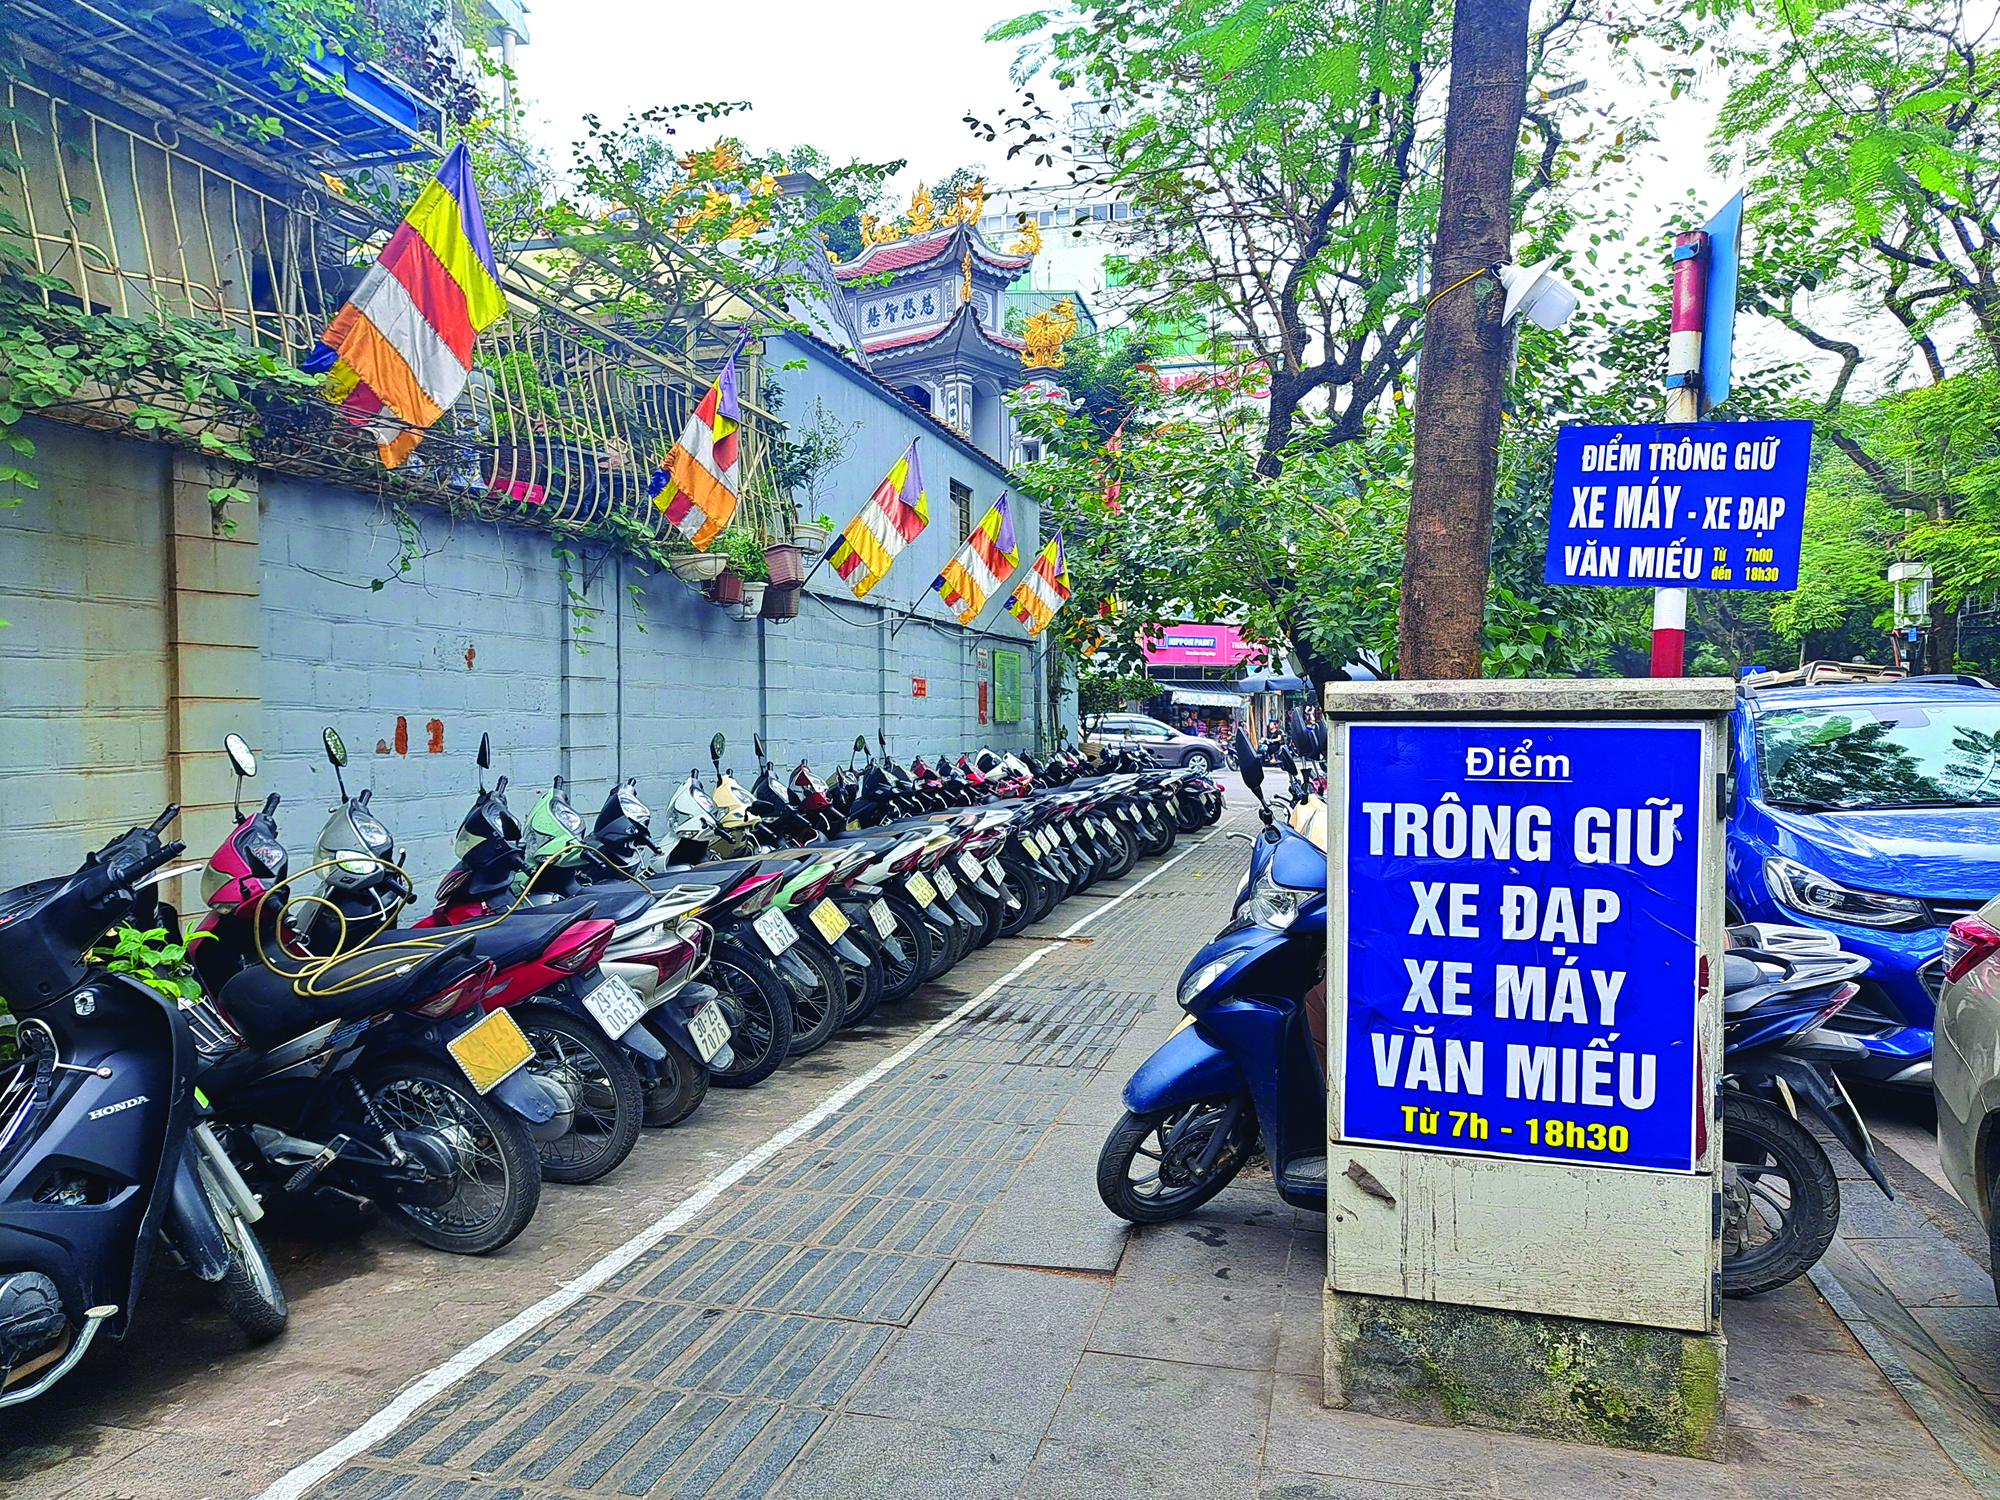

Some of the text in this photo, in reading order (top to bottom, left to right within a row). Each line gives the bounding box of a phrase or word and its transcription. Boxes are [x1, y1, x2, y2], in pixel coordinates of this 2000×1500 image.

[1582, 433, 1780, 471] ĐIỂM TRÔNG GIỮ
[1569, 487, 1606, 528] XE
[1614, 476, 1681, 528] MÁY
[1702, 497, 1732, 529] XE
[1738, 497, 1785, 537] ĐẠP
[1565, 537, 1702, 579] VĂN MIẾU
[1712, 564, 1779, 581] đến 18h30
[1714, 547, 1773, 562] Từ 7h00
[1168, 638, 1215, 647] NIPPON PAINT
[1466, 739, 1569, 777] Điểm
[1363, 792, 1683, 866] TRÔNG GIỮ
[769, 925, 794, 950] 1674
[1409, 881, 1620, 957] XE ĐẠP
[1402, 956, 1626, 1025] XE MÁY
[604, 996, 642, 1032] 0053
[701, 1021, 727, 1056] 7076
[1371, 1025, 1656, 1109] VĂN MIẾU
[88, 1095, 150, 1121] HONDA
[1401, 1106, 1439, 1134] Từ
[1449, 1111, 1487, 1139] 7h
[1526, 1119, 1629, 1153] 18h30
